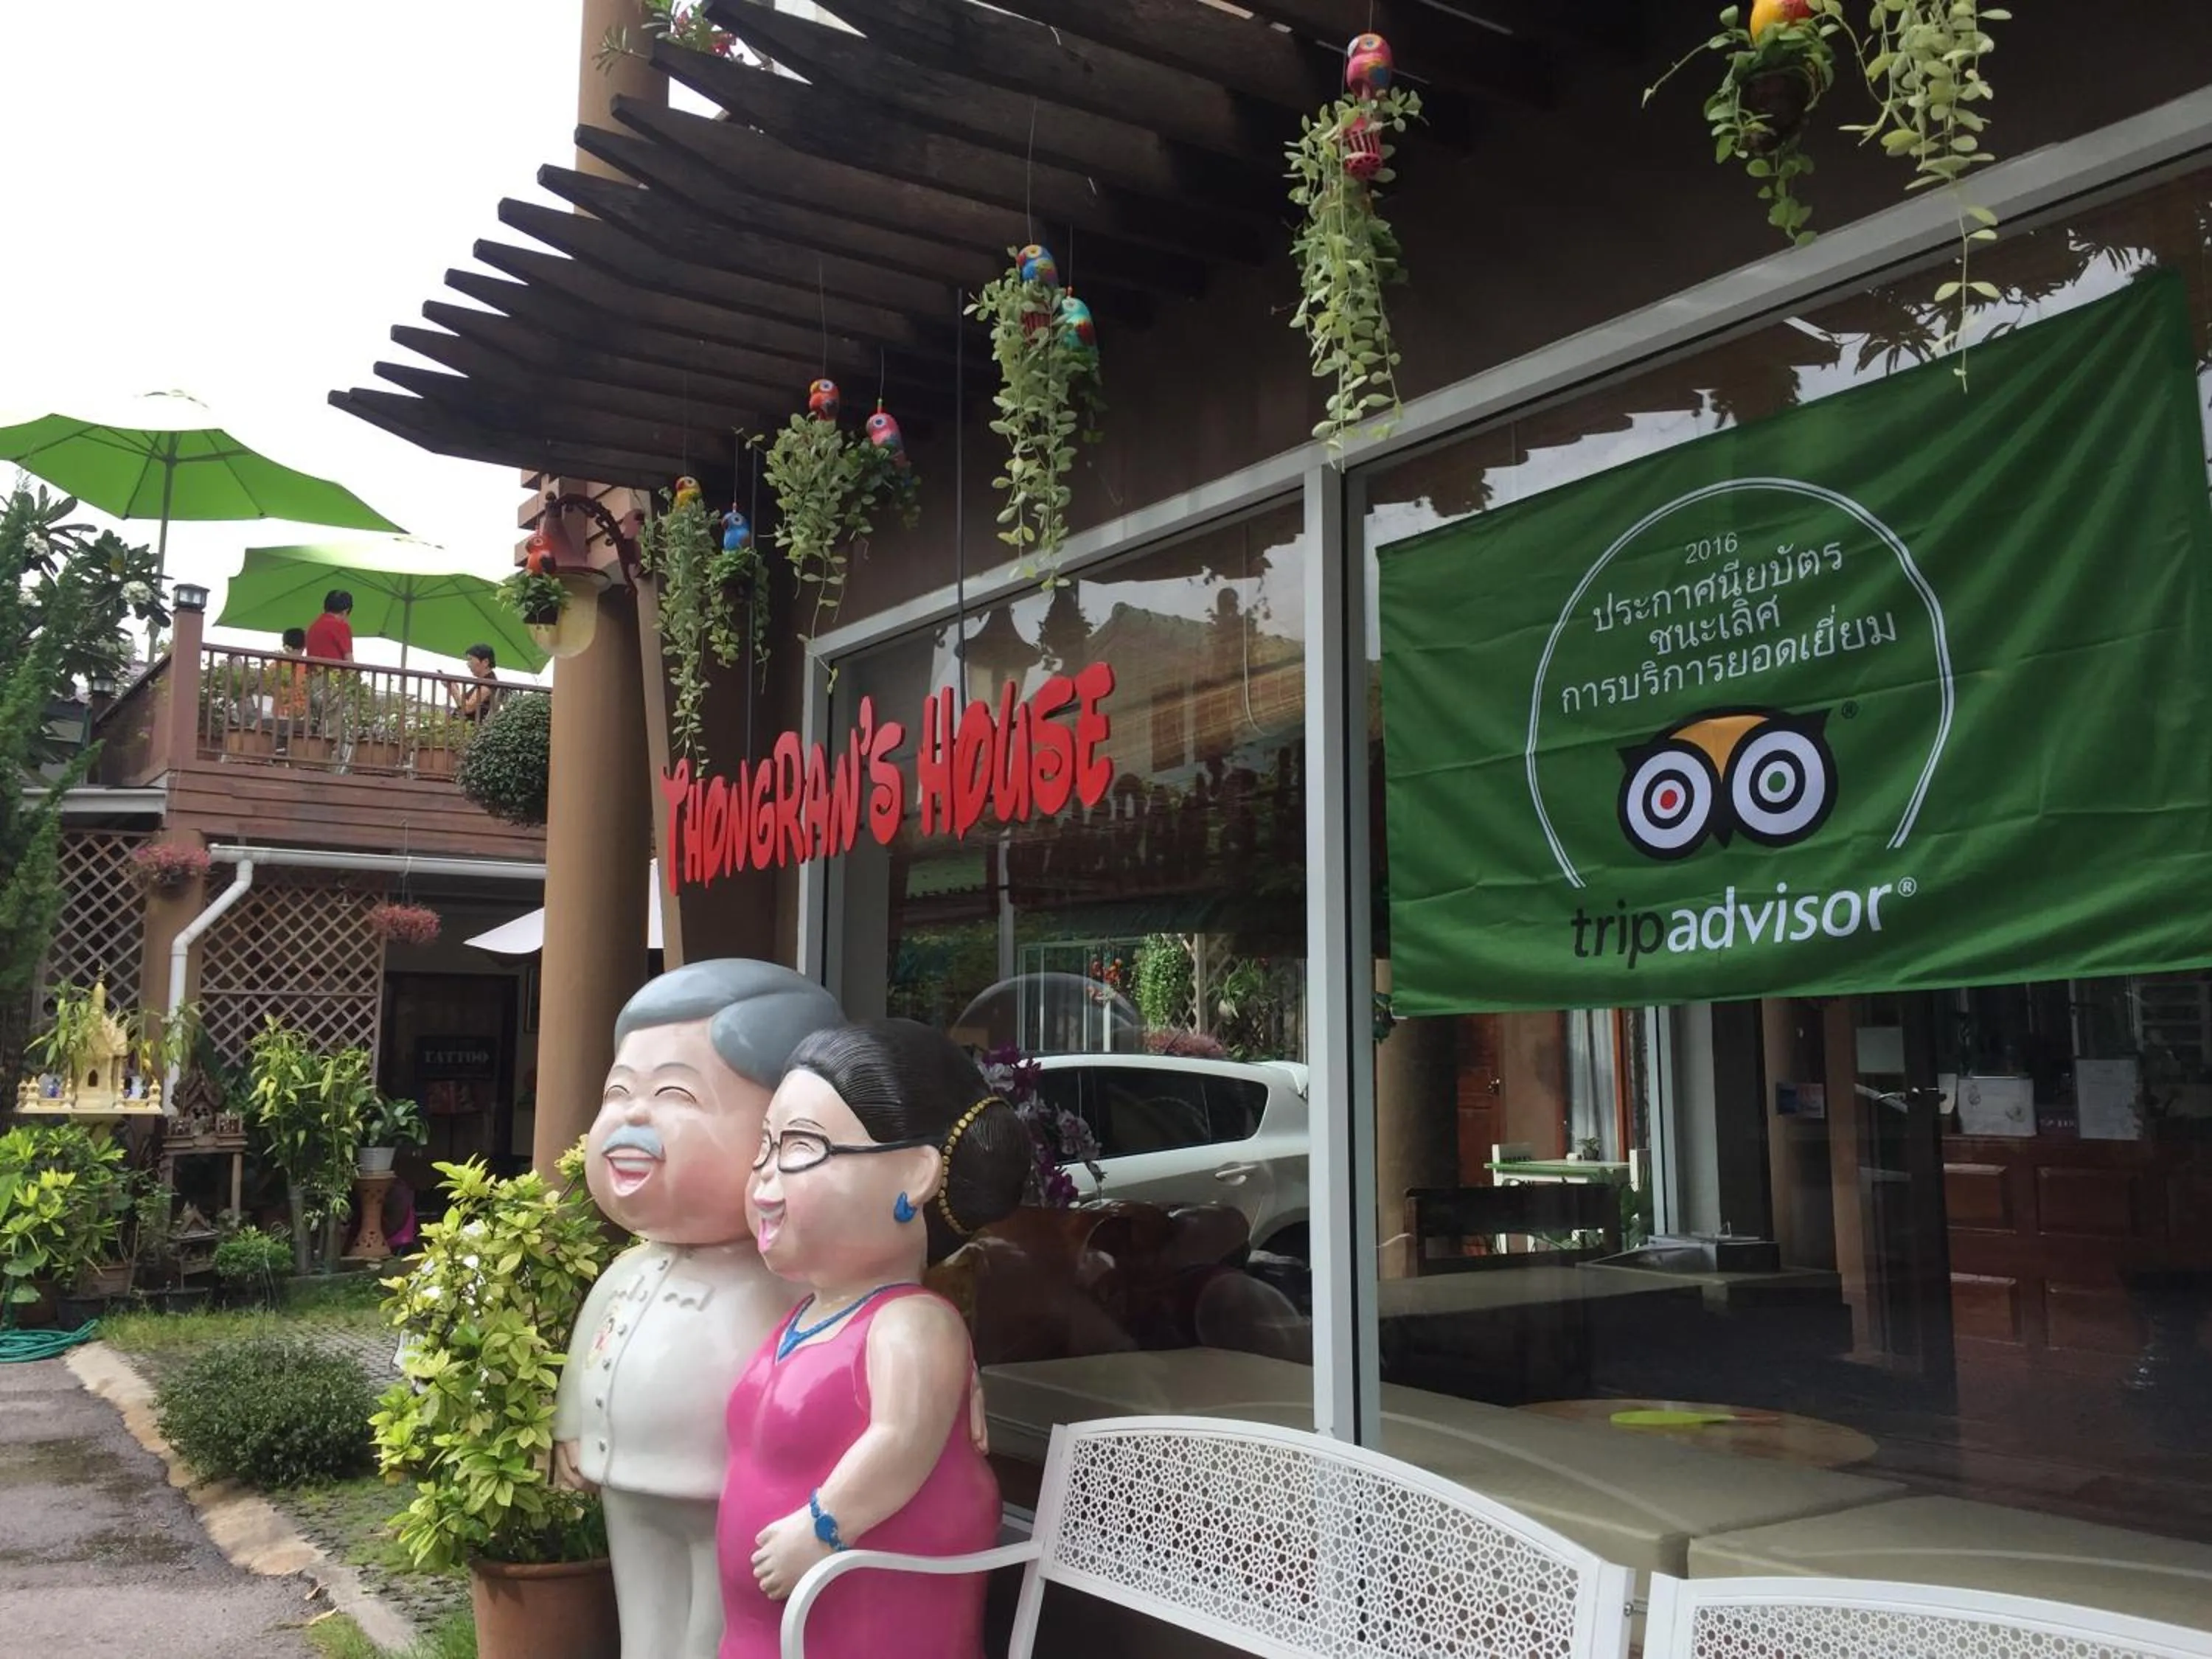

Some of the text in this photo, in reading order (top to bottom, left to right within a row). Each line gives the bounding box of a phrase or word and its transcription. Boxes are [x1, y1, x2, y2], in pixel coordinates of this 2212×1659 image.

[1686, 532, 1738, 564] 2016
[1593, 542, 1843, 632] ประกาศนียบัตร
[1649, 594, 1780, 655] ชนะเลิศ
[1562, 605, 1897, 714] การบริการยอดเยี่ยม
[917, 661, 1115, 841] HOUSE
[425, 1049, 490, 1064] TATTOO
